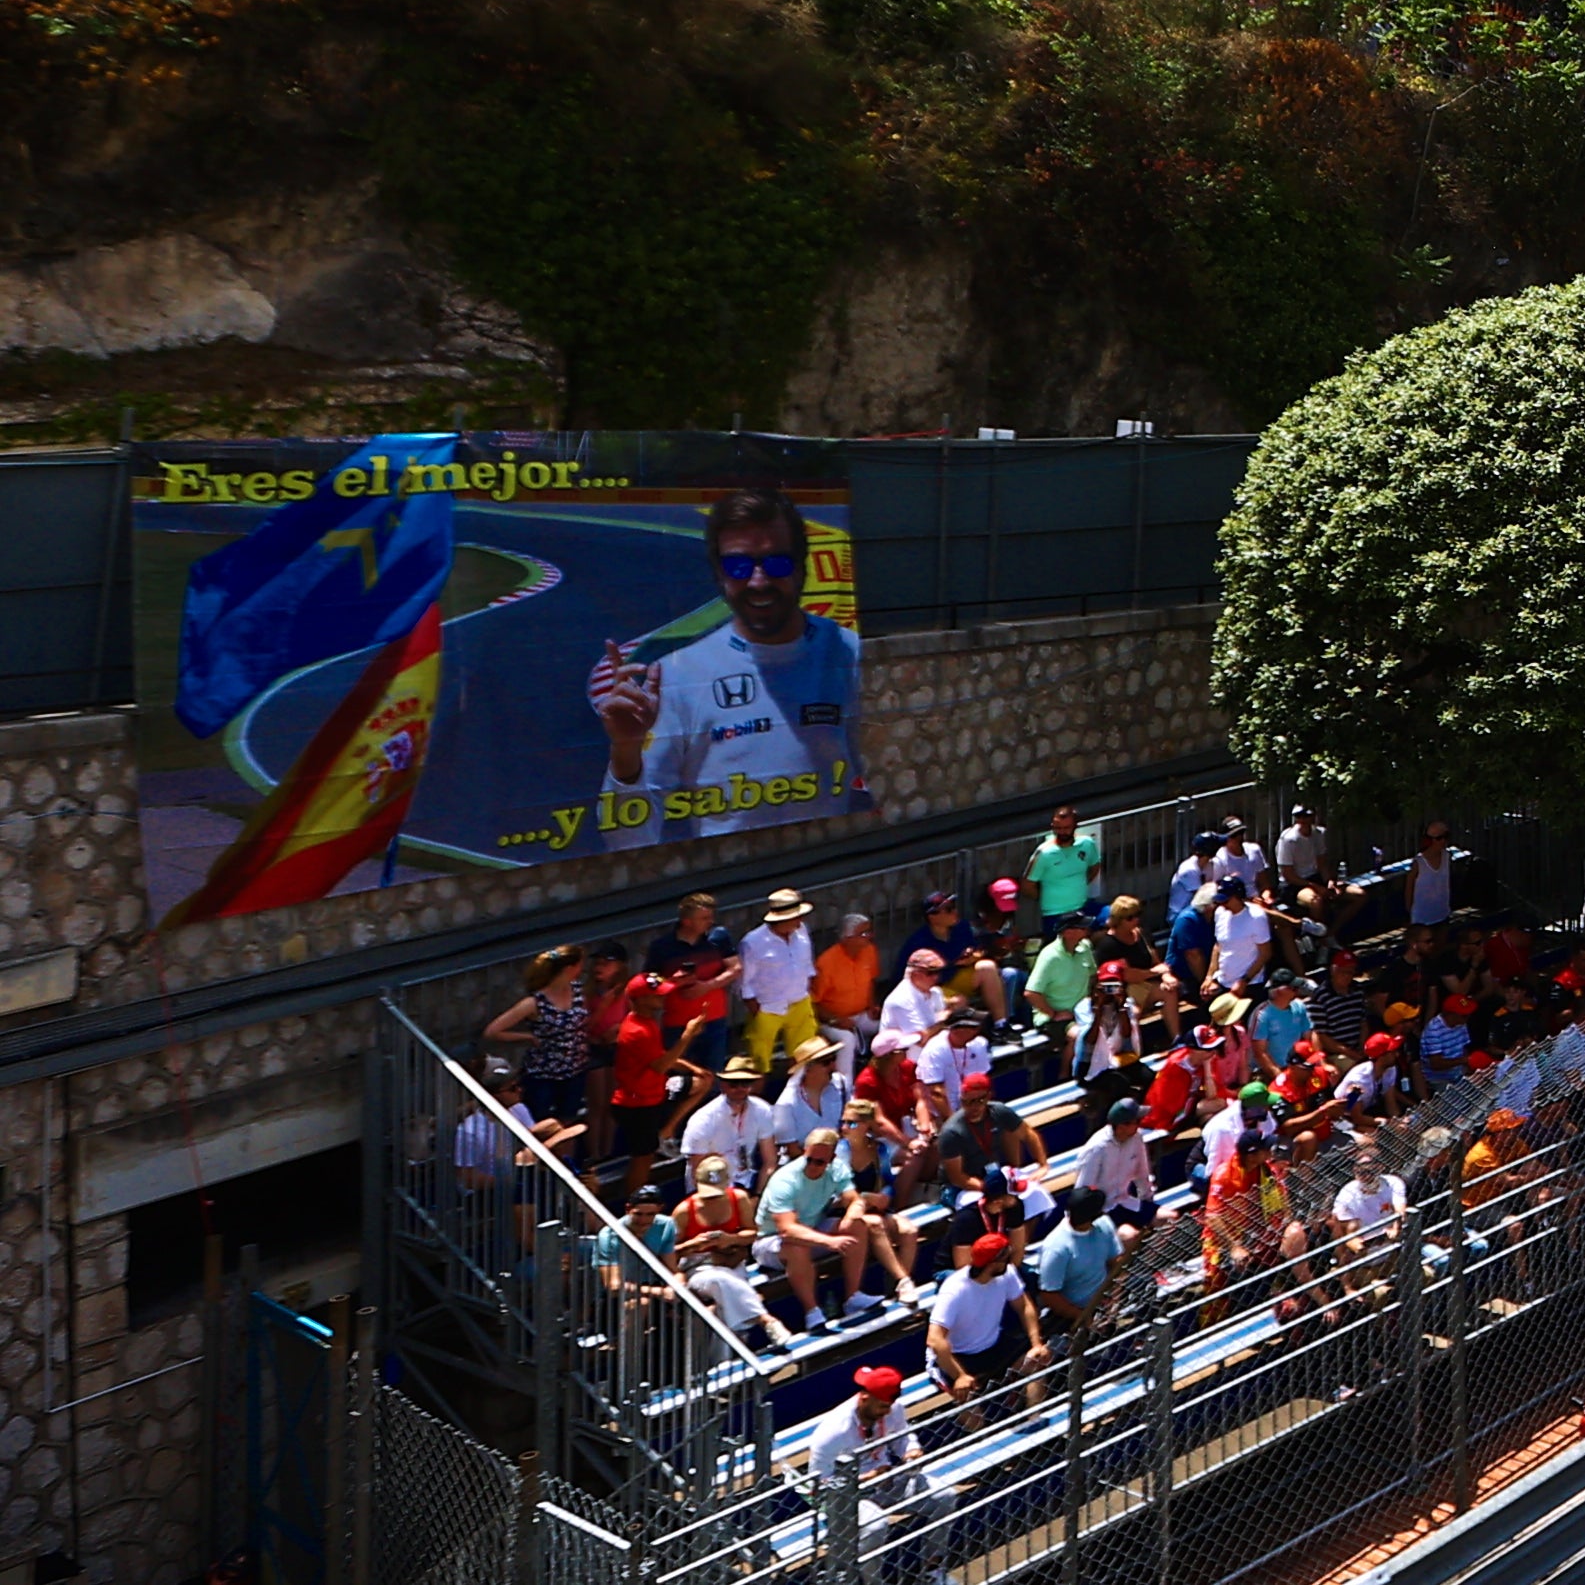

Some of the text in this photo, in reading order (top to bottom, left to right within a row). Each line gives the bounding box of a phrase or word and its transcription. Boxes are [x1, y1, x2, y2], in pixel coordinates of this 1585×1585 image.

[158, 461, 315, 504] Eres
[333, 455, 389, 498] el
[598, 791, 649, 831] lo
[664, 772, 820, 820] sabes
